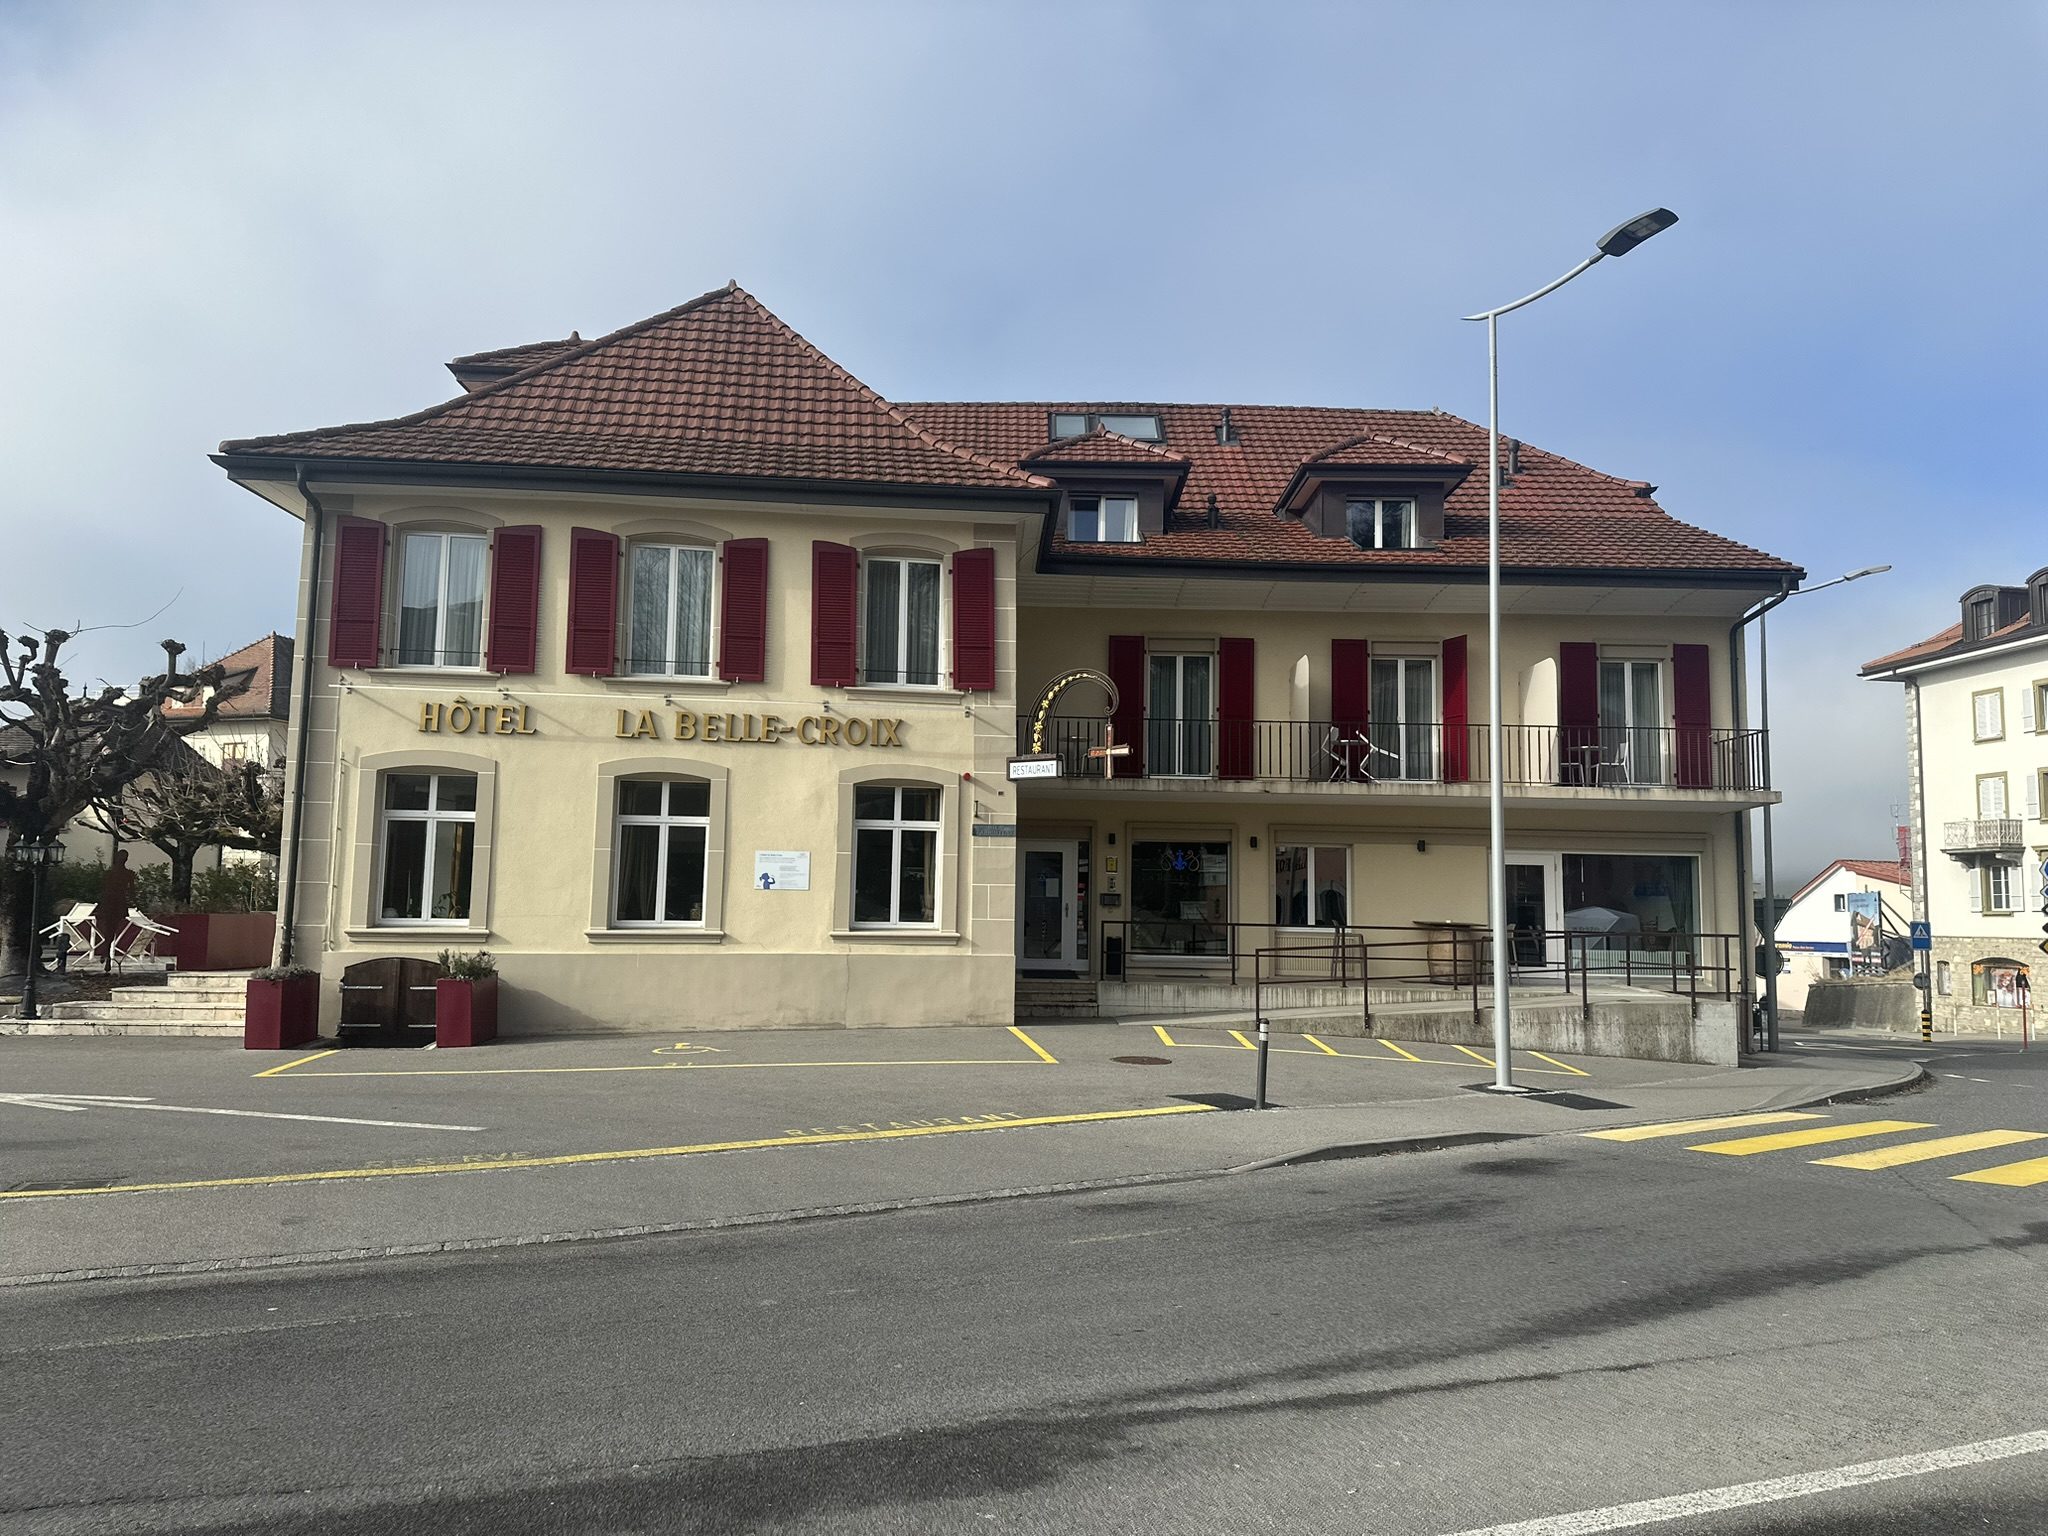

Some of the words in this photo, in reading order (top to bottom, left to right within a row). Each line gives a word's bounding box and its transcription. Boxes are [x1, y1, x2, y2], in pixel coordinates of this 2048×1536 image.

[419, 695, 536, 734] HÔTEL
[615, 709, 660, 739] LA
[674, 710, 904, 747] BELLE-CROIX
[1012, 763, 1055, 776] RESTAURANT
[783, 1111, 1024, 1137] RESTAURANT
